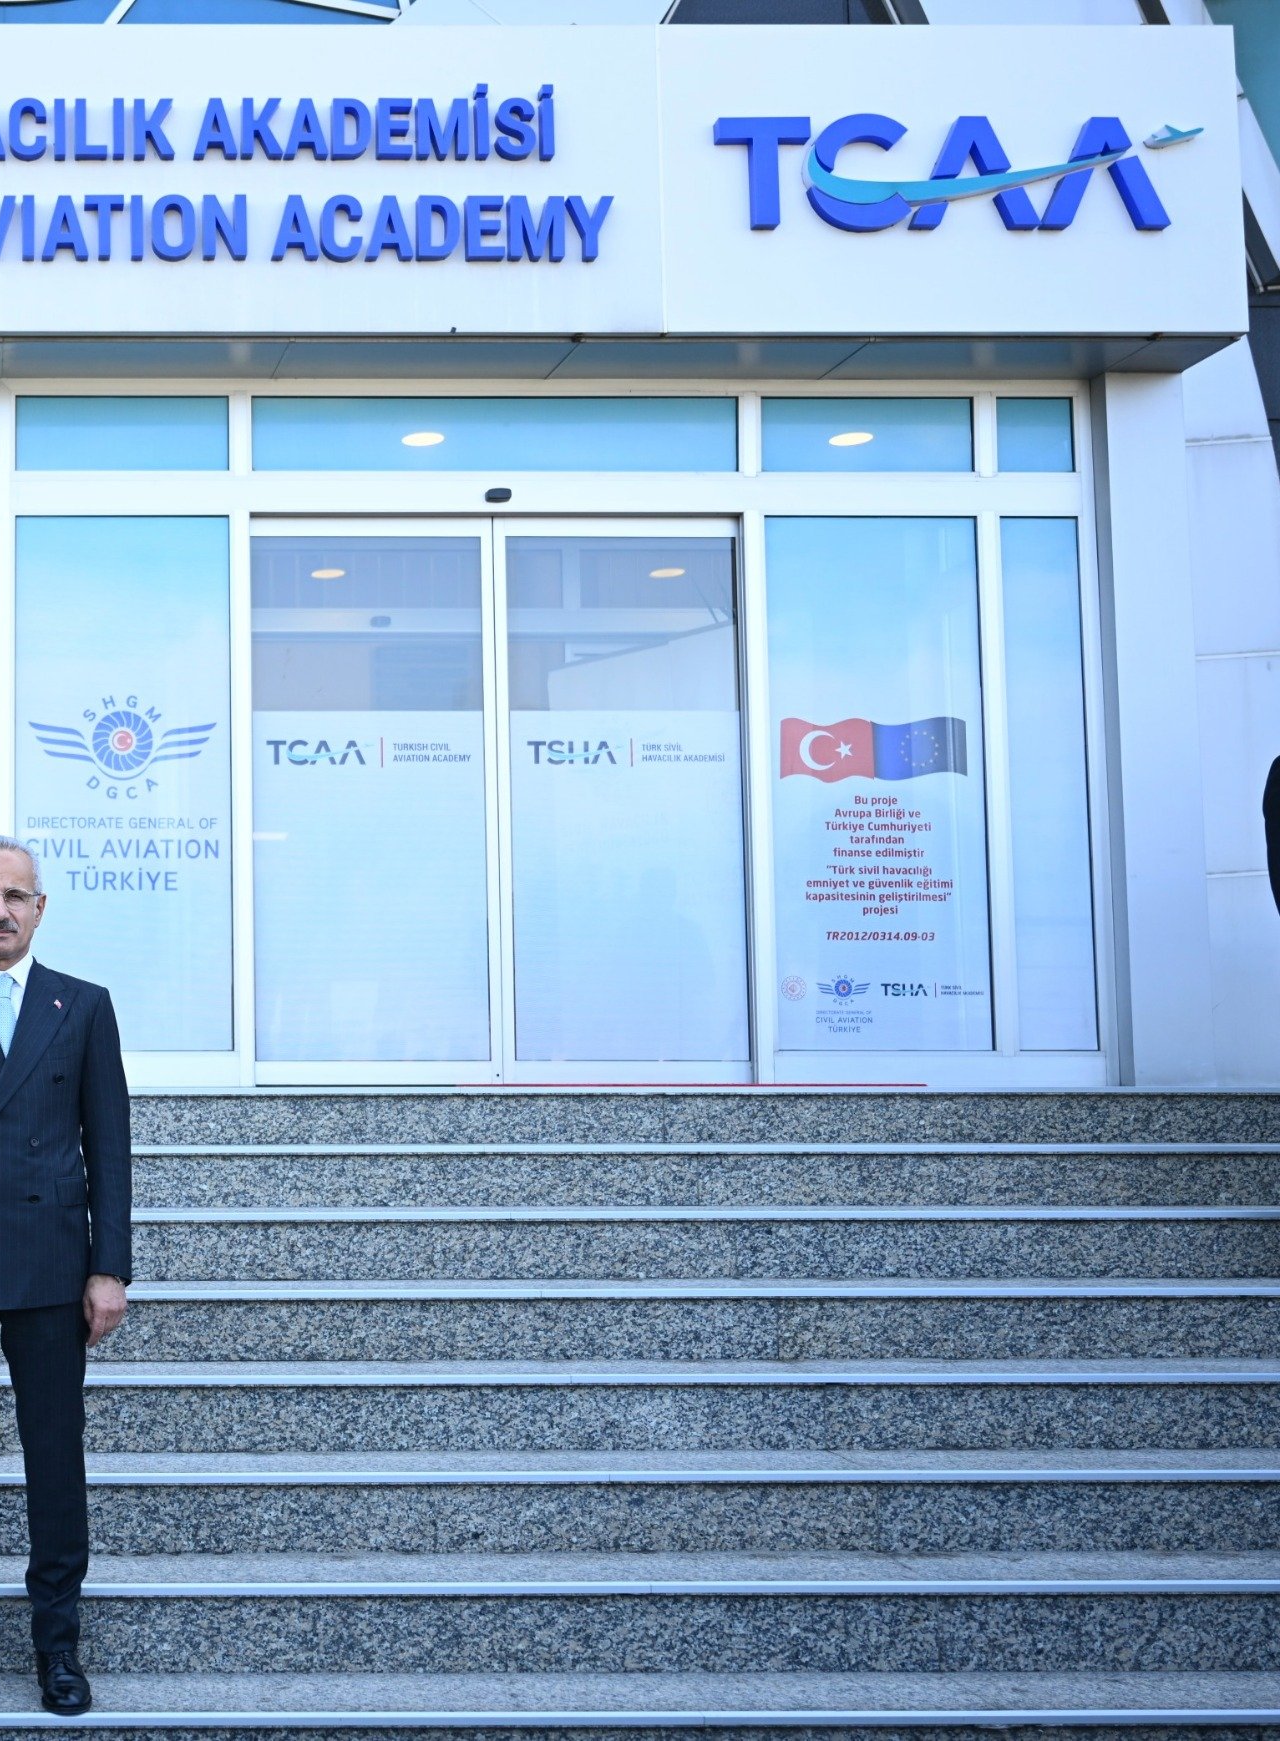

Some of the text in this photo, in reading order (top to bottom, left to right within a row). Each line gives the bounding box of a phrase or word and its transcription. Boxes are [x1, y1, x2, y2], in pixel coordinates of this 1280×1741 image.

[193, 83, 554, 162] AKADEMİSİ
[713, 113, 1173, 232] TCAA
[271, 194, 614, 263] ACADEMY
[83, 695, 162, 723] SHGM
[266, 740, 366, 765] TCAA
[393, 743, 451, 751] TURKISH CIVIL
[527, 740, 617, 765] TSHA
[642, 743, 683, 751] TÜRK SİVİL
[393, 754, 471, 762] AVIATION ACADEMY
[683, 754, 725, 762] AKADEMİSİ
[86, 775, 159, 799] DGCA
[855, 796, 898, 806] Bu proje
[835, 809, 920, 820] Avrupa Birliği ve
[27, 817, 217, 829] DIRECTORATE GENERAL OF
[825, 822, 931, 833] Türkiye Cumhuriyeti
[850, 835, 904, 844] tarafından
[101, 839, 219, 859] AVIATION
[834, 848, 924, 859] finanse edilmiştir
[859, 866, 879, 875] sivil
[883, 866, 932, 877] havacılığı
[67, 866, 178, 891] TÜRKİYE
[806, 879, 849, 890] emniyet
[869, 879, 913, 889] güvenlik
[917, 879, 953, 890] eğitimi
[806, 892, 875, 902] kapasitesinin
[863, 905, 898, 916] projesi
[881, 983, 928, 997] TSHA
[829, 1025, 860, 1033] TÜRKİYE
